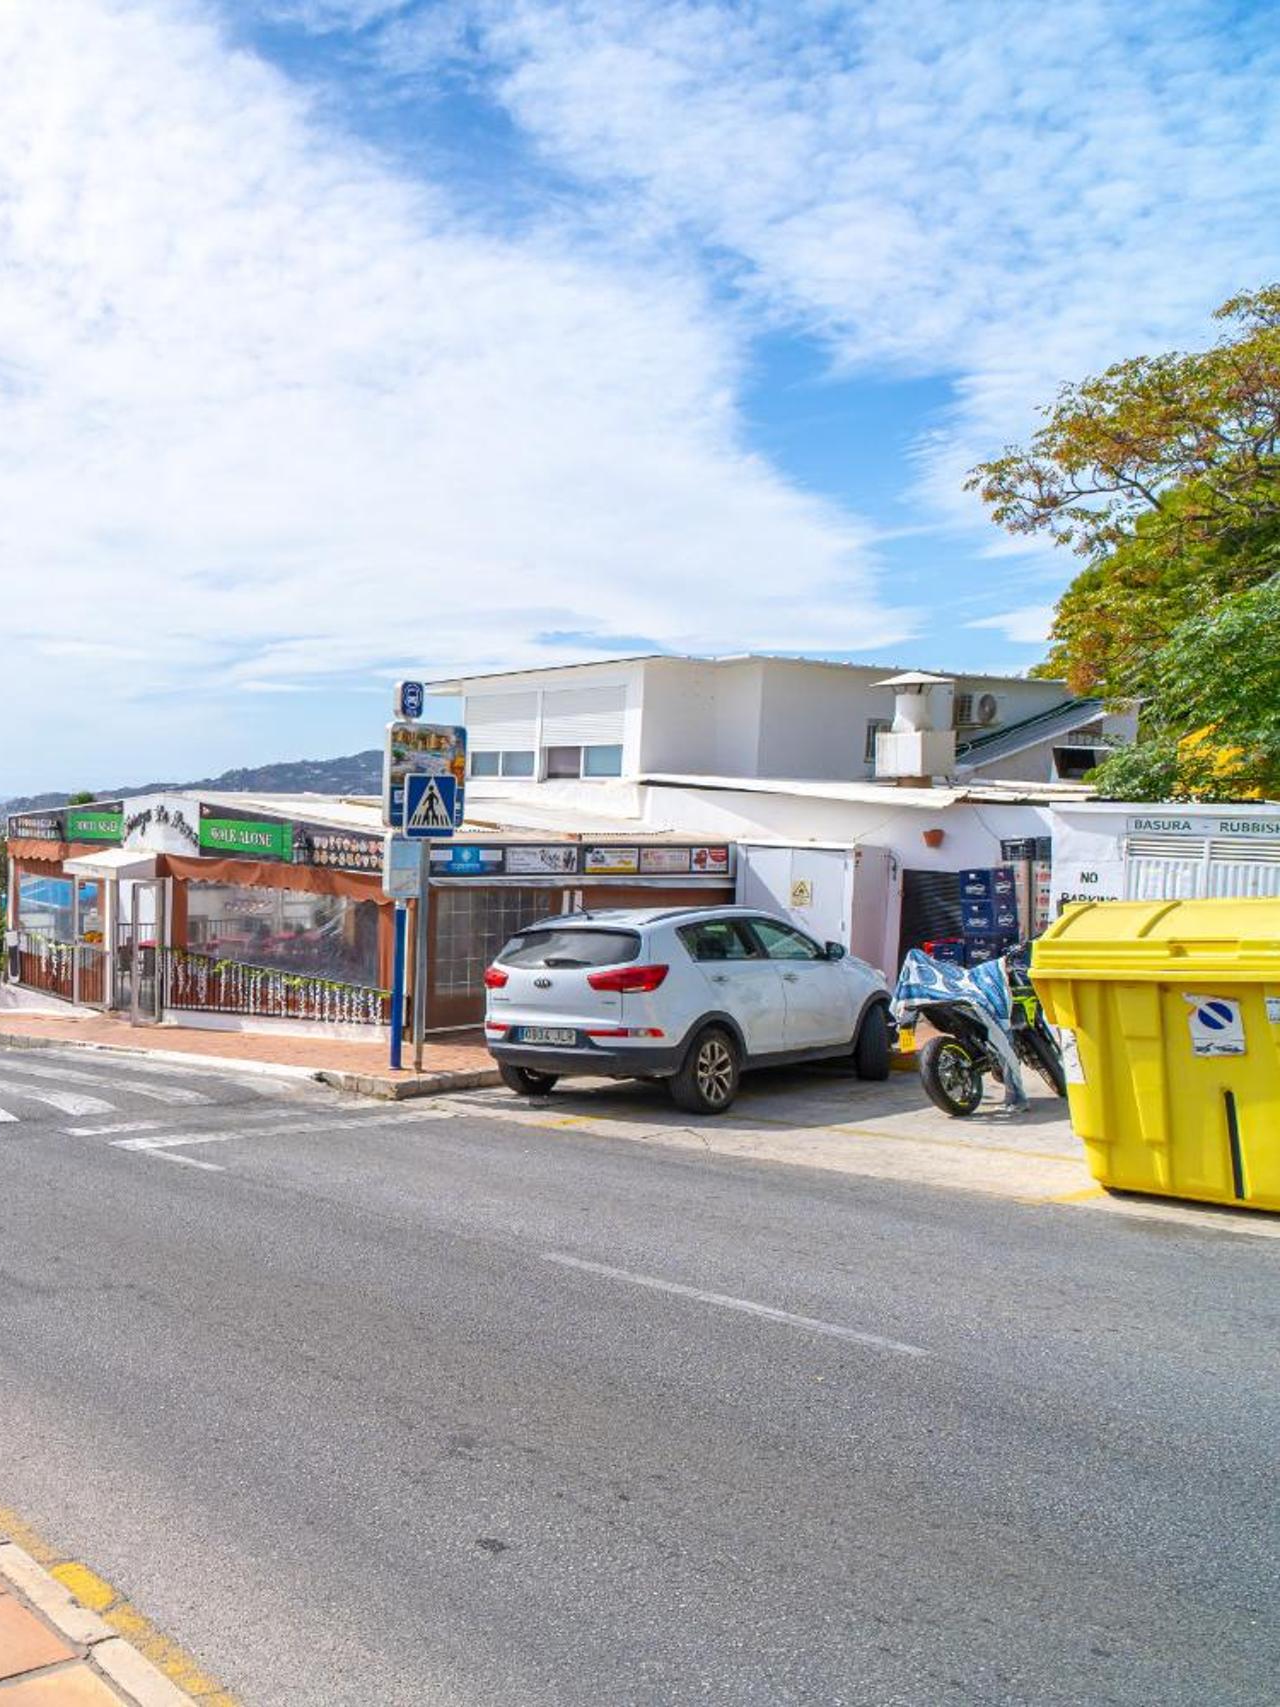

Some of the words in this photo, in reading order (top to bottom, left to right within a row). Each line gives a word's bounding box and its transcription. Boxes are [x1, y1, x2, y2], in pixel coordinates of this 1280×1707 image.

[1134, 820, 1192, 831] BASURA
[239, 830, 273, 847] ALONE
[1080, 871, 1099, 884] NO
